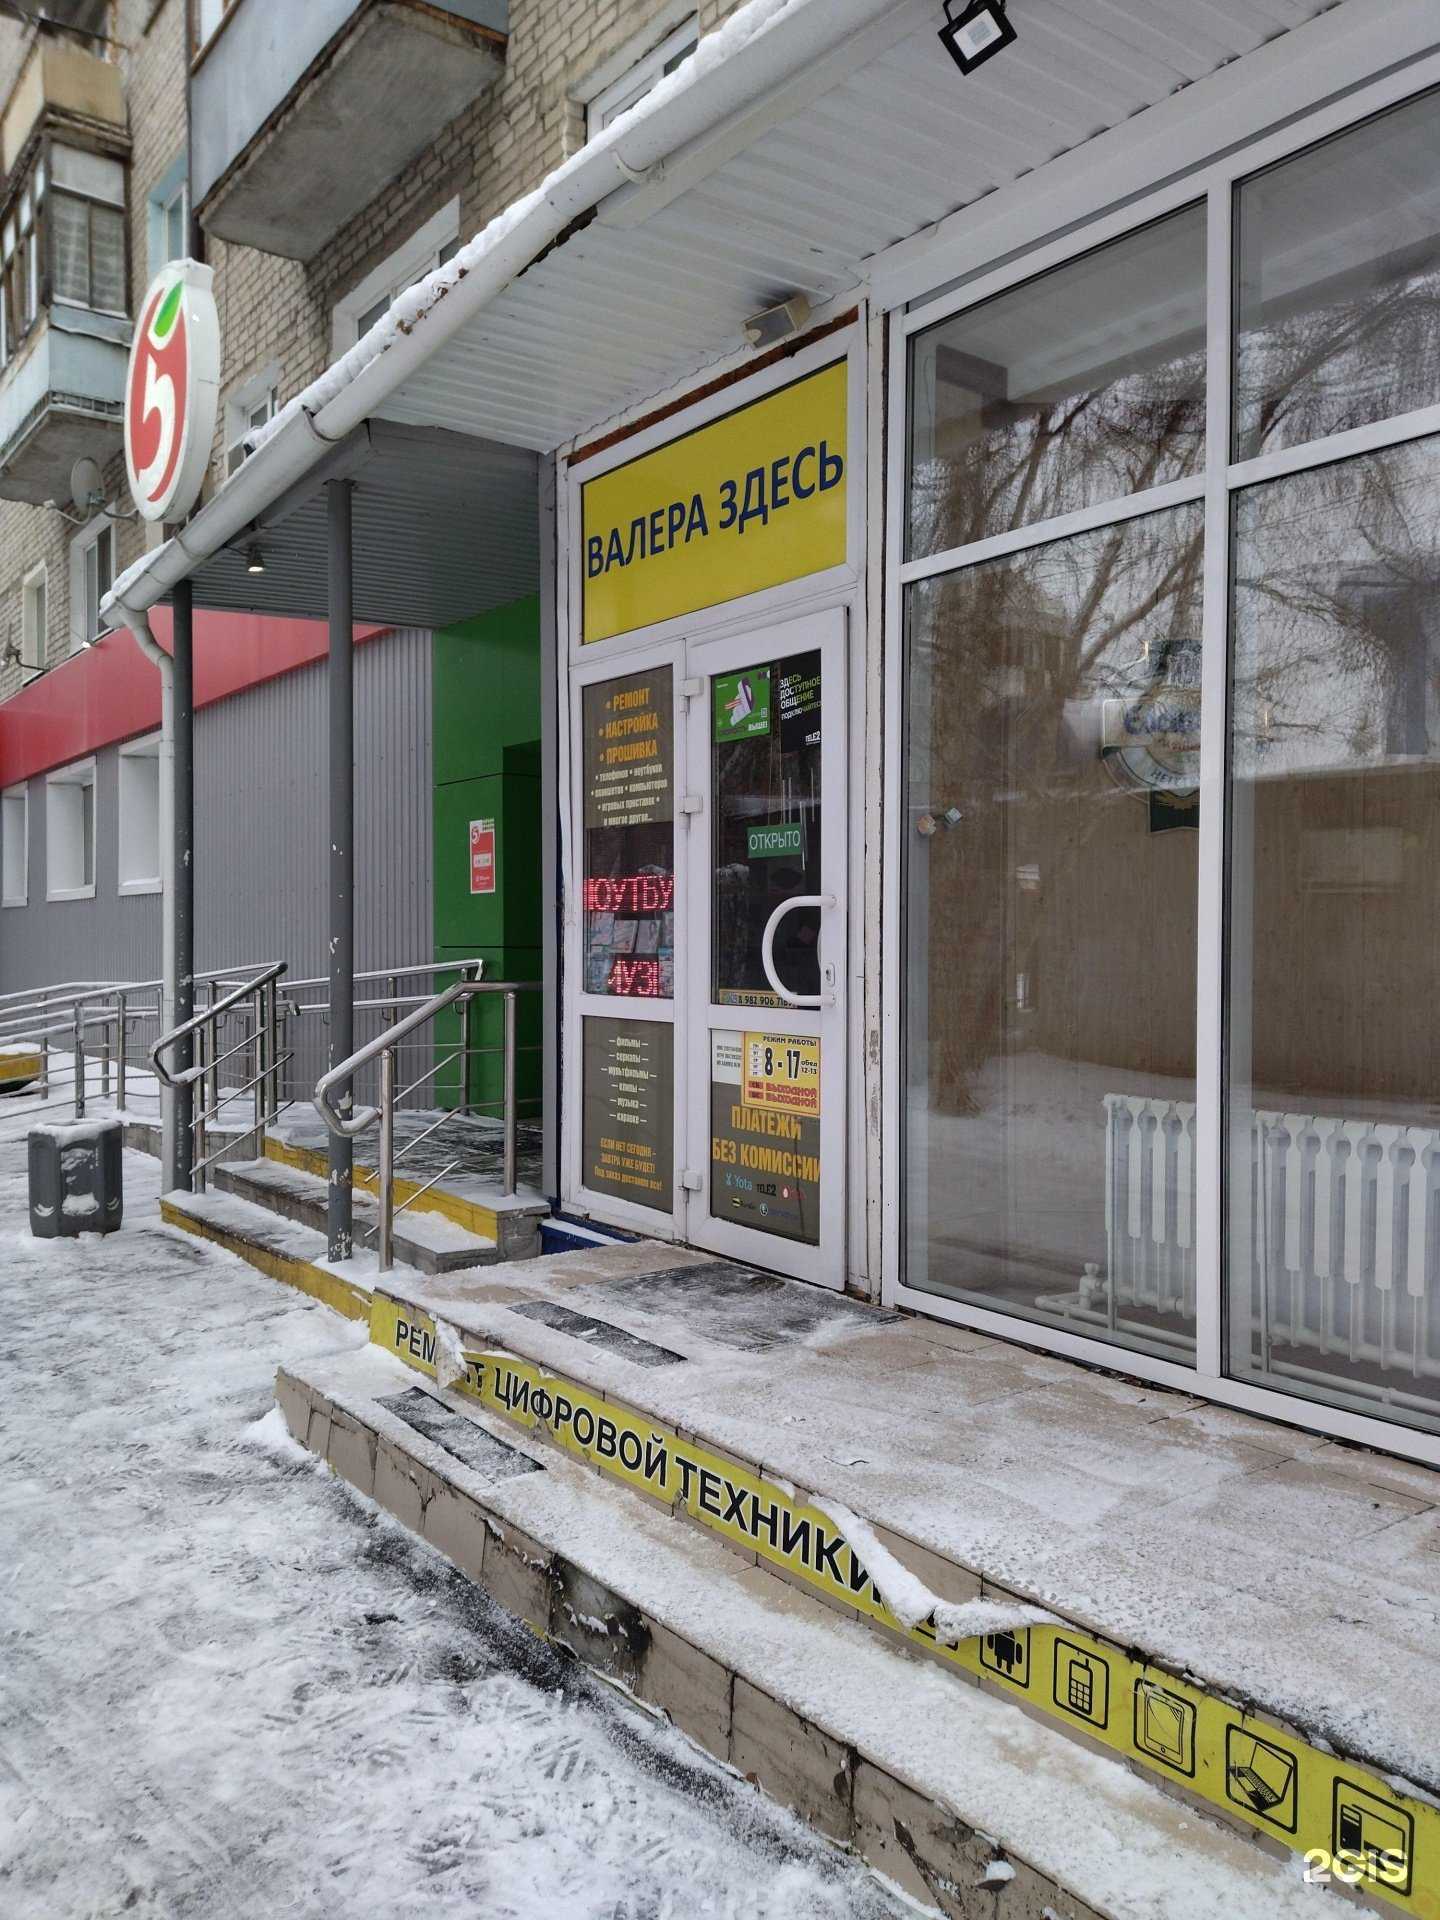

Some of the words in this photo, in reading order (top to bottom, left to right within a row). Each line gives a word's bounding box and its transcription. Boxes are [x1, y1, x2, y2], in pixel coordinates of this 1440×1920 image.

[587, 494, 709, 578] ВАЛЕРА
[719, 440, 844, 534] ЗДЕСЬ
[780, 674, 802, 689] ЗДЕСЬ
[780, 676, 821, 700] ДОСТУПНОЕ
[613, 688, 650, 712] РЕМОНТ
[780, 690, 815, 709] ОБЩЕНИЕ
[606, 712, 657, 739] НАСТРОЙКА
[805, 731, 821, 742] TELE2
[606, 740, 657, 764] ПРОШИВКА
[750, 830, 800, 850] ОТКРЫТО
[763, 1036, 786, 1044] РЕЖИМ
[788, 1038, 817, 1047] РАБОТЫ
[764, 1047, 774, 1076] 8
[786, 1049, 801, 1079] 17
[801, 1067, 817, 1075] 12-13
[766, 1083, 818, 1098] ВЫХОДНОЙ
[766, 1093, 818, 1109] ВЫХОДНОЙ
[731, 1105, 802, 1141] ПЛАТЕЖИ
[712, 1137, 737, 1165] БЕЗ
[740, 1143, 820, 1183] КОМИССИИ
[734, 1175, 753, 1191] Yota
[756, 1183, 777, 1196] TELE2
[396, 1319, 485, 1390] РЕМТ
[494, 1366, 668, 1488] ЦИФРОВОЙ
